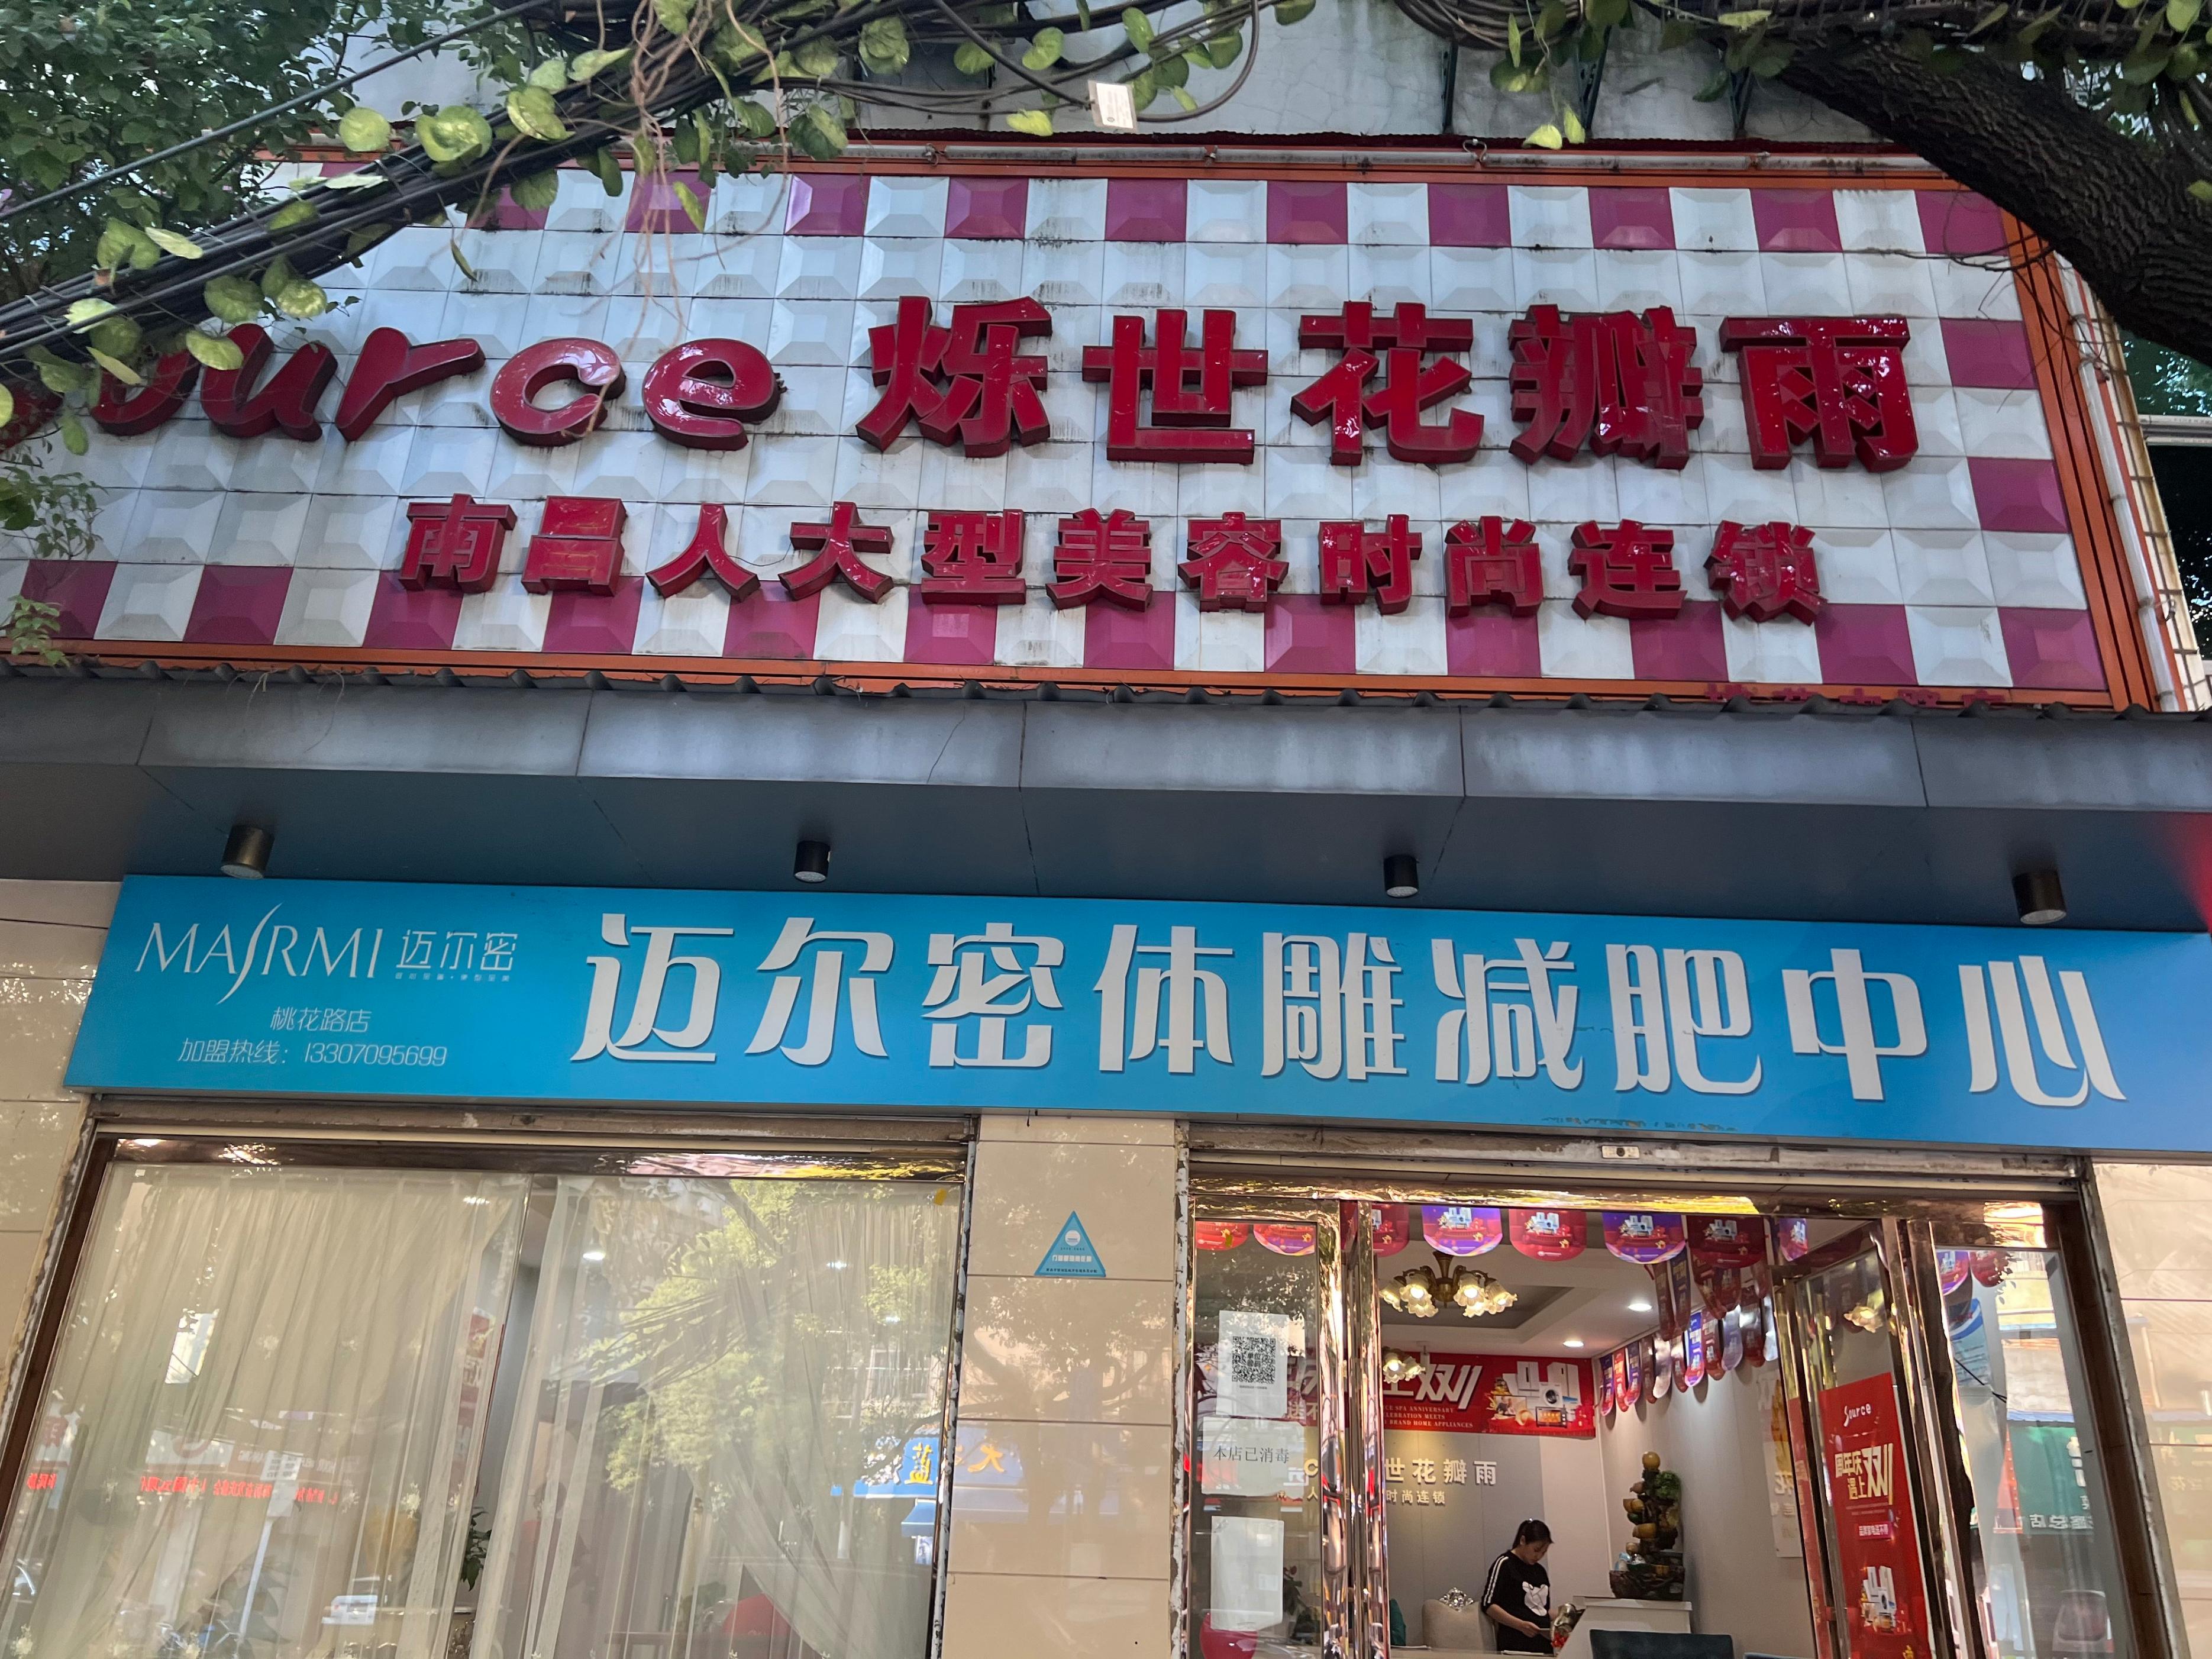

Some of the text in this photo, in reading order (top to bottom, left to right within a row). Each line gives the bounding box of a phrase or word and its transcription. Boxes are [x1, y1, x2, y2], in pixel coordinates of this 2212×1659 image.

[856, 296, 1917, 470] 烁世花瓣雨
[400, 493, 1827, 626] 南昌人大型美容时尚连锁
[396, 929, 518, 971] 迈尔密
[270, 1006, 373, 1033] 桃花路店
[570, 912, 2129, 1108] 迈尔密体雕减肥中心
[304, 1042, 447, 1066] 13307095699
[1213, 1445, 1290, 1464] 本店已消毒
